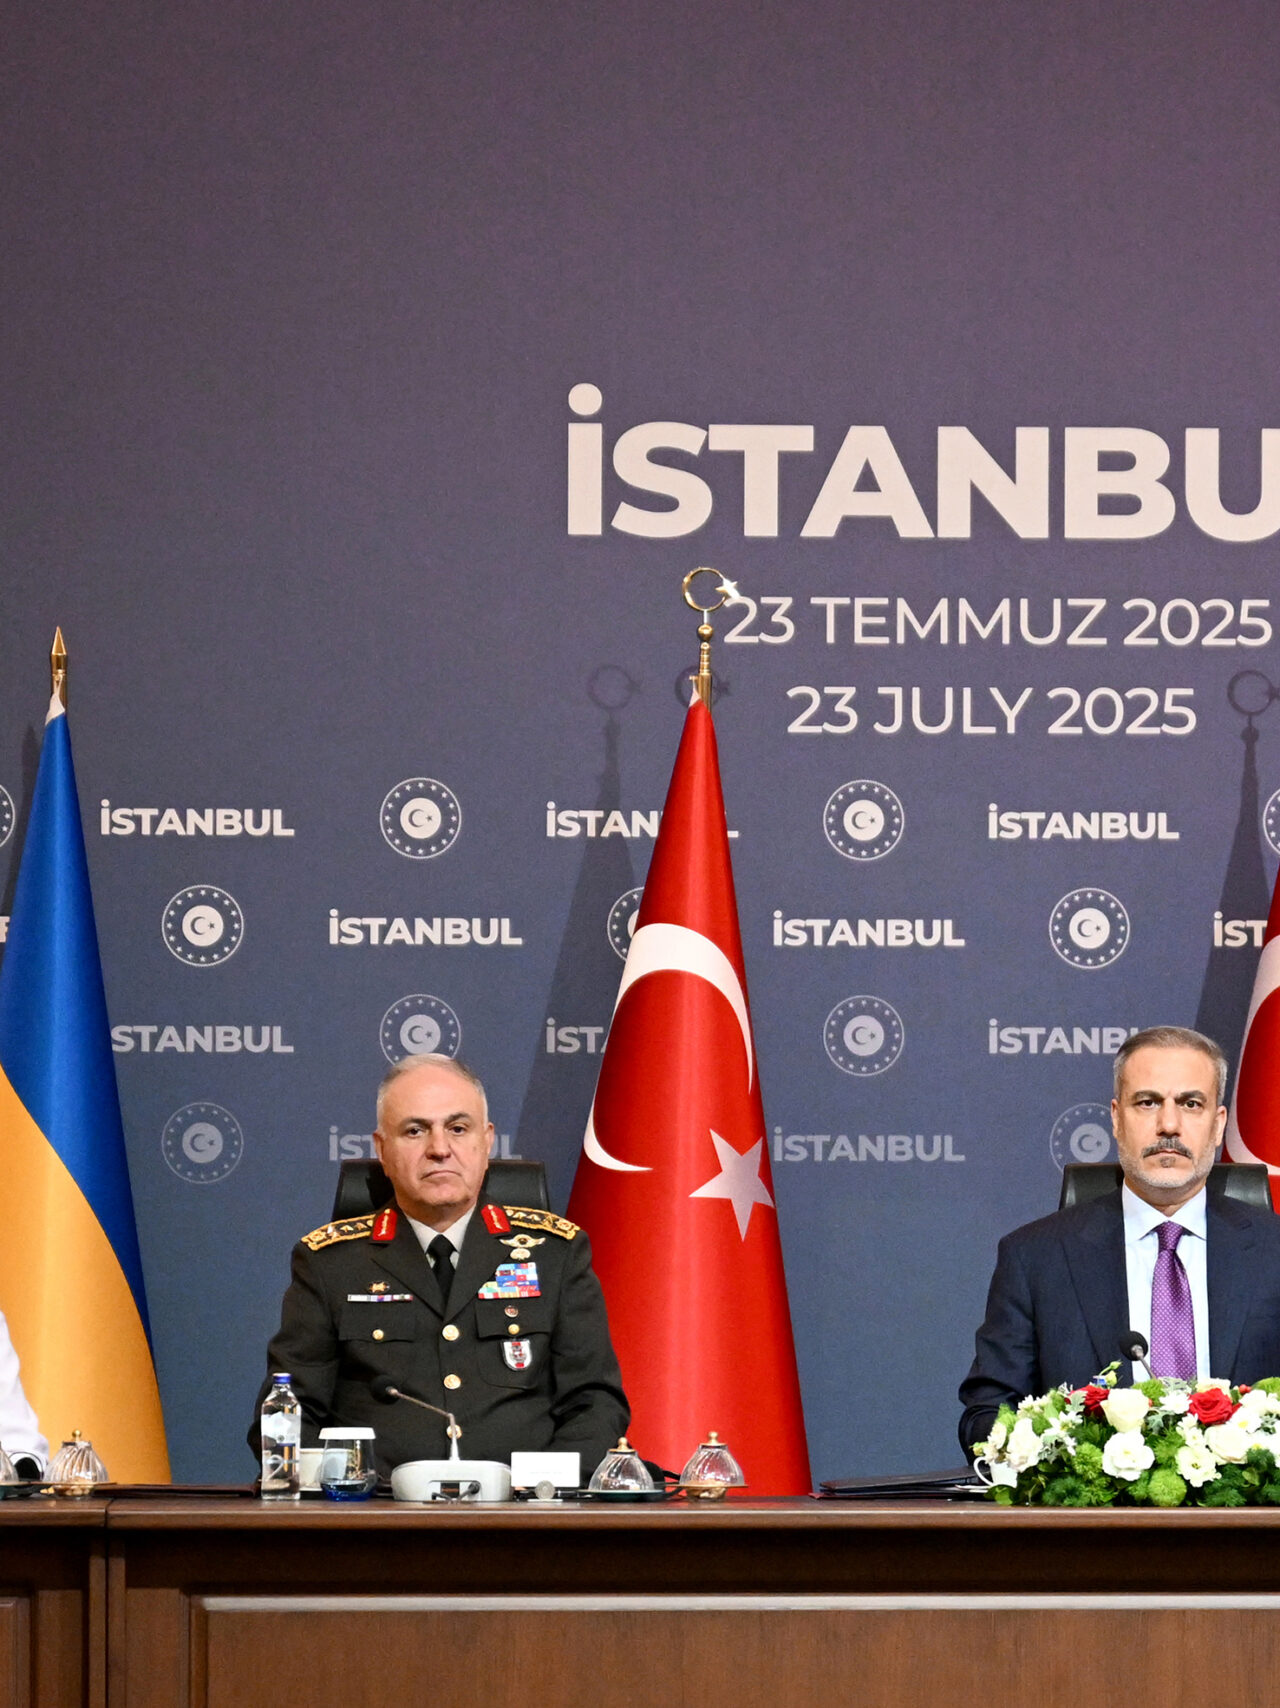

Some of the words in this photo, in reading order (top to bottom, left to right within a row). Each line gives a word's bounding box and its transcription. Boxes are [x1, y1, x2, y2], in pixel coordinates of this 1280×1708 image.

[723, 596, 795, 644] 23
[810, 596, 1108, 646] TEMMUZ
[1122, 598, 1273, 647] 2025
[786, 686, 858, 734] 23
[873, 686, 1034, 734] JULY
[1046, 686, 1197, 735] 2025
[101, 799, 295, 837] İSTANBUL
[546, 801, 740, 838] İSTAN
[988, 802, 1180, 840] İSTANBUL
[329, 908, 523, 946] İSTANBUL
[773, 909, 966, 947] İSTANBUL
[111, 1025, 295, 1053] STANBUL
[988, 1018, 1138, 1055] İSTANB
[773, 1126, 966, 1162] İSTANBUL
